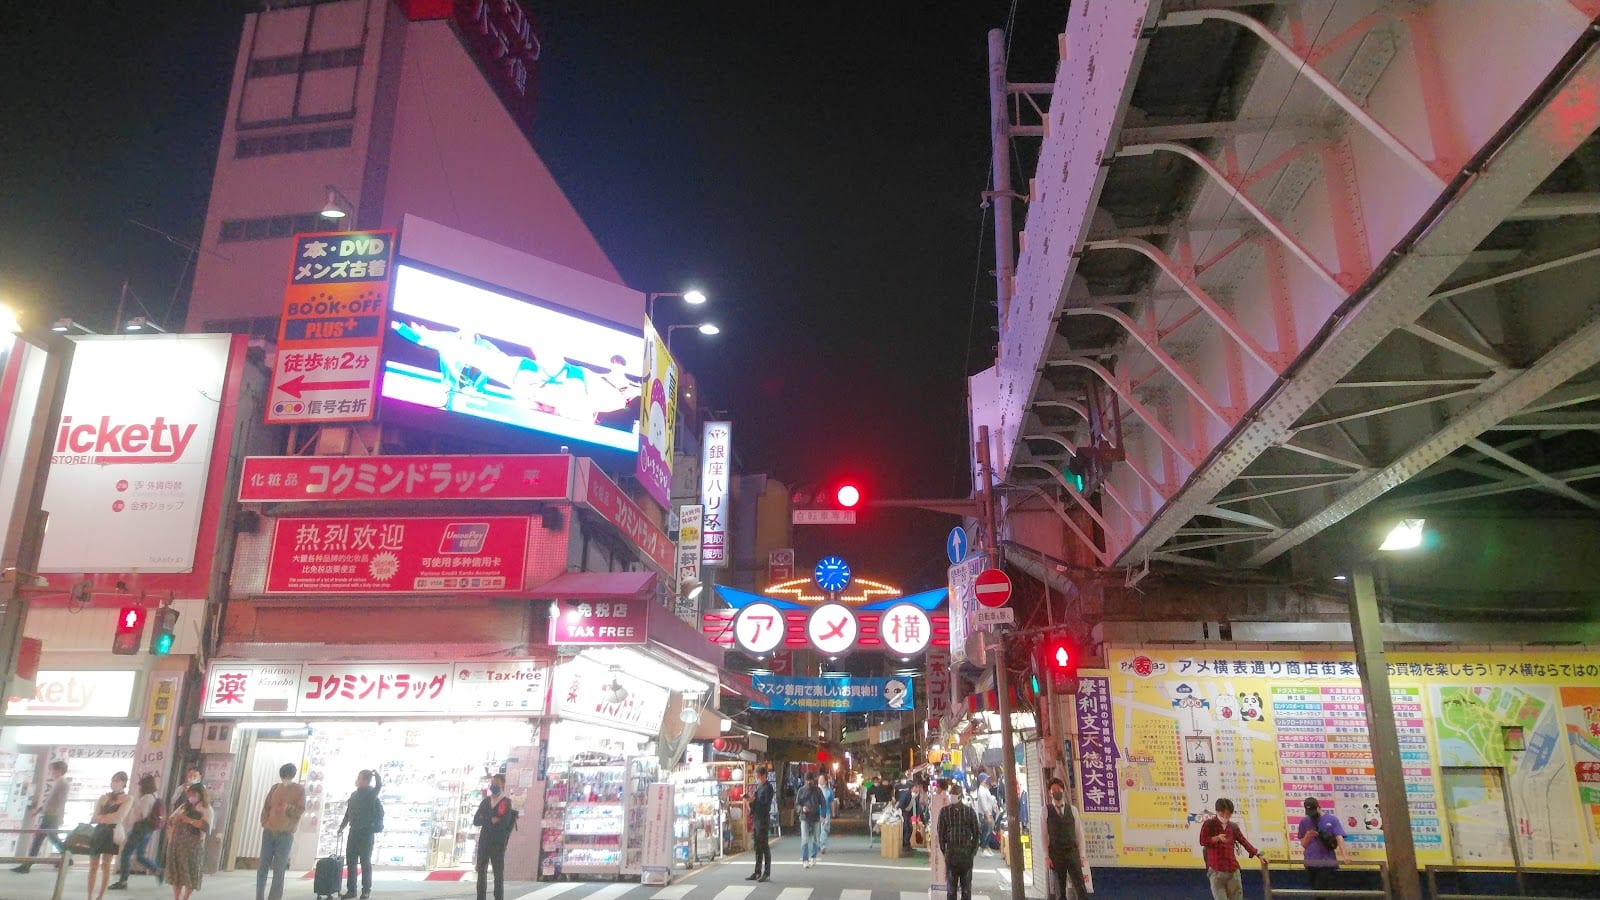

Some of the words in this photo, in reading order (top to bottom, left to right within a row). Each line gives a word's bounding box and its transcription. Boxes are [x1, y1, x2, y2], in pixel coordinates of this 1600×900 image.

[294, 259, 386, 281] メンズ古着
[284, 351, 370, 372] 徒歩約2分
[307, 399, 367, 414] 信号右折
[250, 473, 298, 487] 化粧品
[305, 462, 504, 495] コクミンドラッグ
[294, 523, 406, 552] 热烈欢迎
[703, 532, 724, 546] 買取
[421, 557, 502, 568] 可使用多种信用卡
[577, 602, 629, 619] 免税店
[566, 626, 595, 638] TAX
[598, 626, 635, 638] FREE
[746, 613, 921, 645] アメ横
[486, 669, 543, 681] Tax-free
[1178, 659, 1361, 676] アメ横表通り商店街案
[1496, 663, 1600, 677] アメ横ならではの
[215, 672, 249, 705] 薬
[305, 673, 447, 700] コクミンドラッグ
[756, 682, 878, 698] マスク着用で楽しいお買物!!
[1077, 678, 1106, 805] 摩利支天徳大寺
[140, 751, 164, 764] JCB
